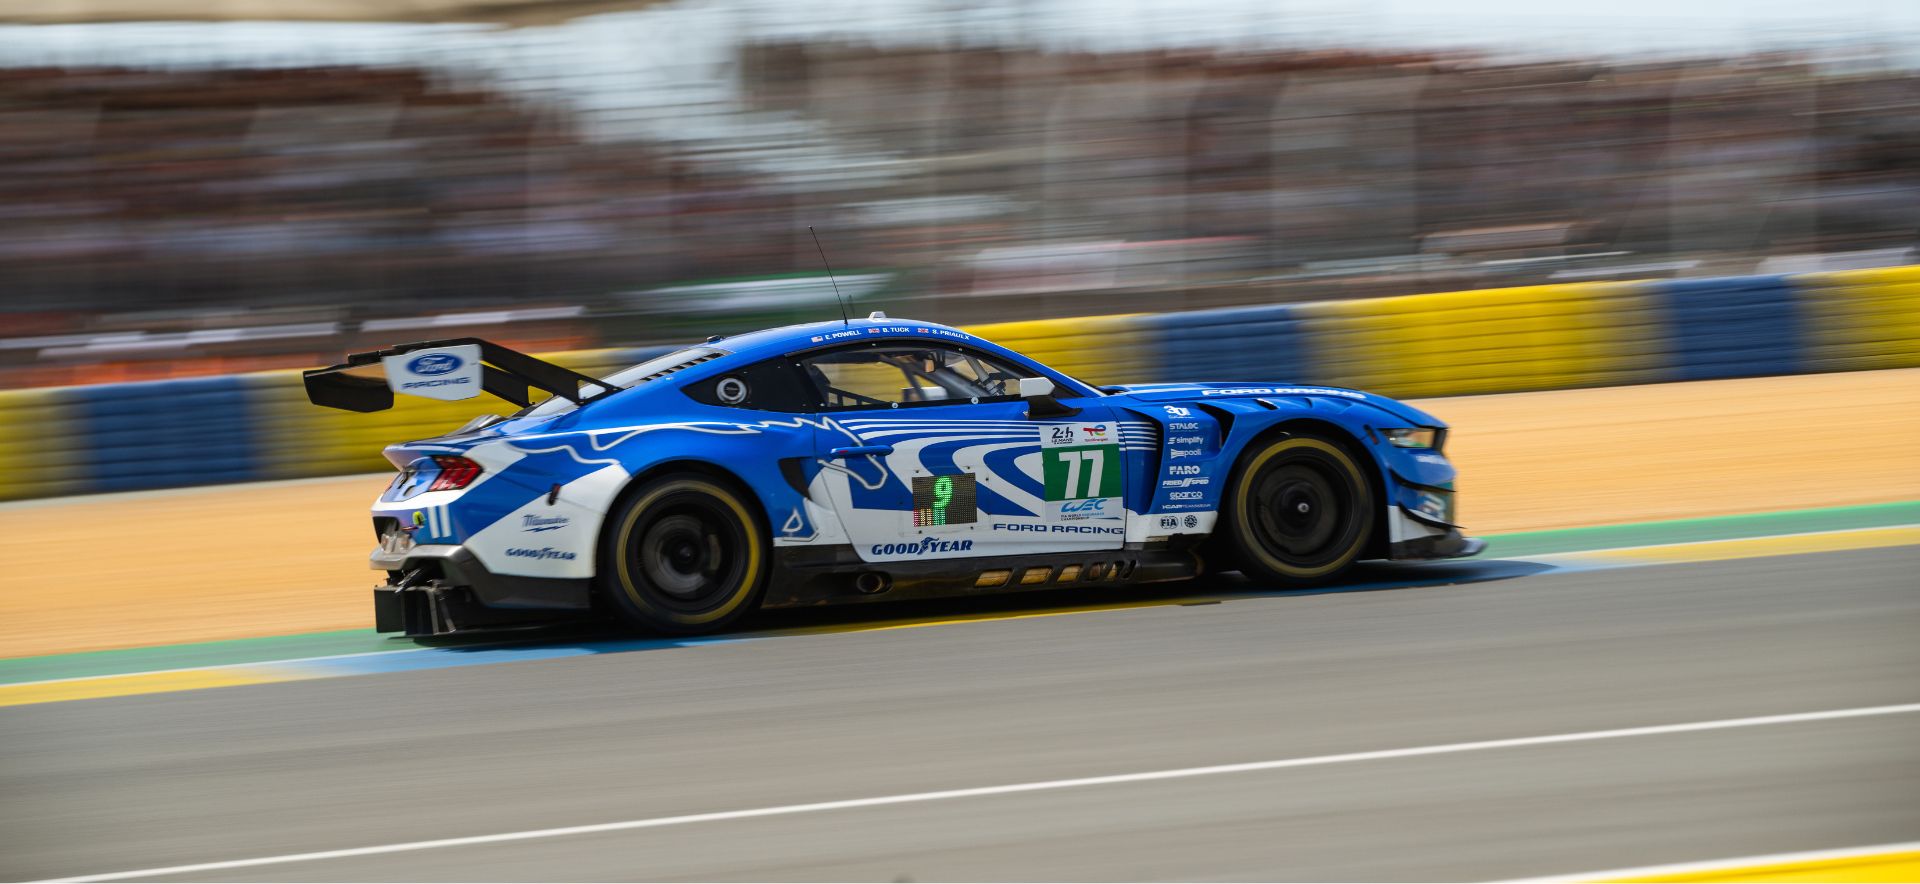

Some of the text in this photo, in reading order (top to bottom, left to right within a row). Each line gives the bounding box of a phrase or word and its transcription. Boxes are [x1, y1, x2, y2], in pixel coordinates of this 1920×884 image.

[832, 330, 861, 339] POWELL
[940, 330, 970, 340] PRIAULX
[415, 357, 455, 373] Ford
[401, 377, 470, 389] RACING
[1201, 388, 1366, 399] FORD RACING
[1169, 422, 1199, 430] STALOC
[1176, 436, 1203, 445] simplify
[1058, 449, 1104, 500] 77
[1169, 465, 1201, 475] FARO
[931, 475, 954, 510] 9
[1169, 491, 1203, 500] sparco
[1060, 498, 1108, 513] WEC
[1161, 518, 1177, 527] FIA
[993, 523, 1124, 535] FORD RACING
